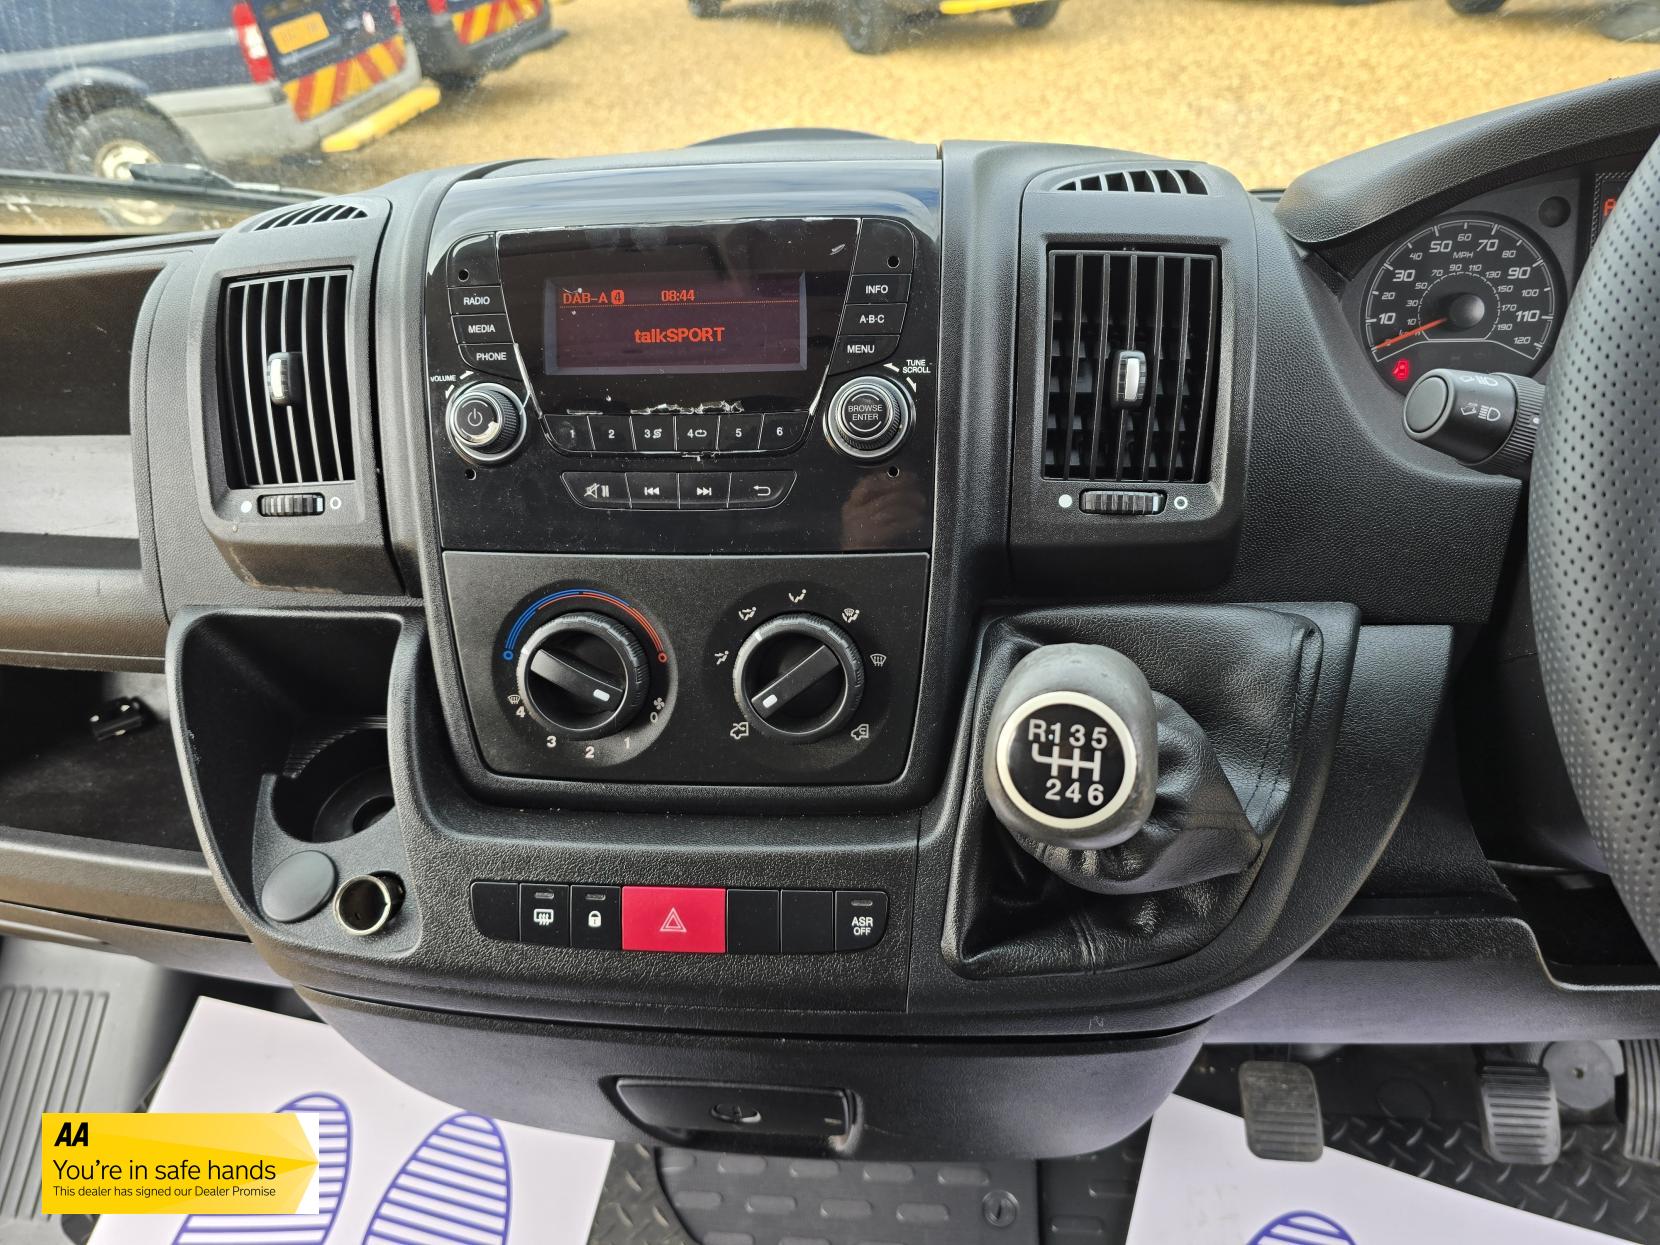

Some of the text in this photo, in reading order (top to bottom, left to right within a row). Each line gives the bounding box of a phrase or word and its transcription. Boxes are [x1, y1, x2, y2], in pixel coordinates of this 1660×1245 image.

[1457, 233, 1472, 241] 60
[1429, 240, 1453, 252] 50
[1476, 239, 1499, 251] 70
[1409, 252, 1423, 261] 40
[1452, 251, 1474, 259] MPH
[1501, 250, 1517, 258] 80
[1449, 264, 1462, 272] 90
[1468, 264, 1482, 272] 110
[1392, 269, 1416, 282] 30
[1431, 269, 1443, 277] 70
[1485, 271, 1501, 279] 130
[1507, 267, 1531, 279] 90
[865, 285, 889, 294] INFO
[1414, 282, 1428, 290] 50
[1497, 285, 1514, 293] 150
[563, 292, 608, 304] DAB-A
[661, 290, 695, 302] 08:44
[1381, 292, 1396, 300] 20
[1521, 289, 1539, 297] 100
[463, 296, 490, 305] RADIO
[1501, 304, 1517, 312] 170
[1379, 312, 1396, 325] 10
[1515, 310, 1540, 322] 110
[1407, 318, 1417, 326] 10
[468, 324, 496, 333] MEDIA
[1497, 323, 1513, 331] 190
[634, 327, 725, 343] talkSPORT
[1513, 336, 1531, 345] 120
[847, 344, 875, 354] MENU
[476, 352, 507, 361] PHONE
[906, 359, 926, 367] TUNE
[902, 366, 931, 374] SCROLL
[430, 374, 457, 383] VOLUME
[848, 404, 883, 413] BROWSE
[852, 413, 879, 421] ENTER
[569, 429, 576, 439] 1
[608, 429, 615, 439] 2
[644, 429, 651, 438] 3
[687, 429, 694, 438] 4
[735, 428, 742, 437] 5
[776, 427, 783, 436] 6
[515, 706, 526, 718] 4
[1028, 718, 1108, 750] R 1 3 5
[546, 735, 557, 748] 3
[623, 736, 631, 749] 1
[584, 746, 595, 759] 2
[1045, 778, 1105, 806] 2 4 6
[851, 916, 874, 927] ASR
[853, 926, 872, 936] OFF
